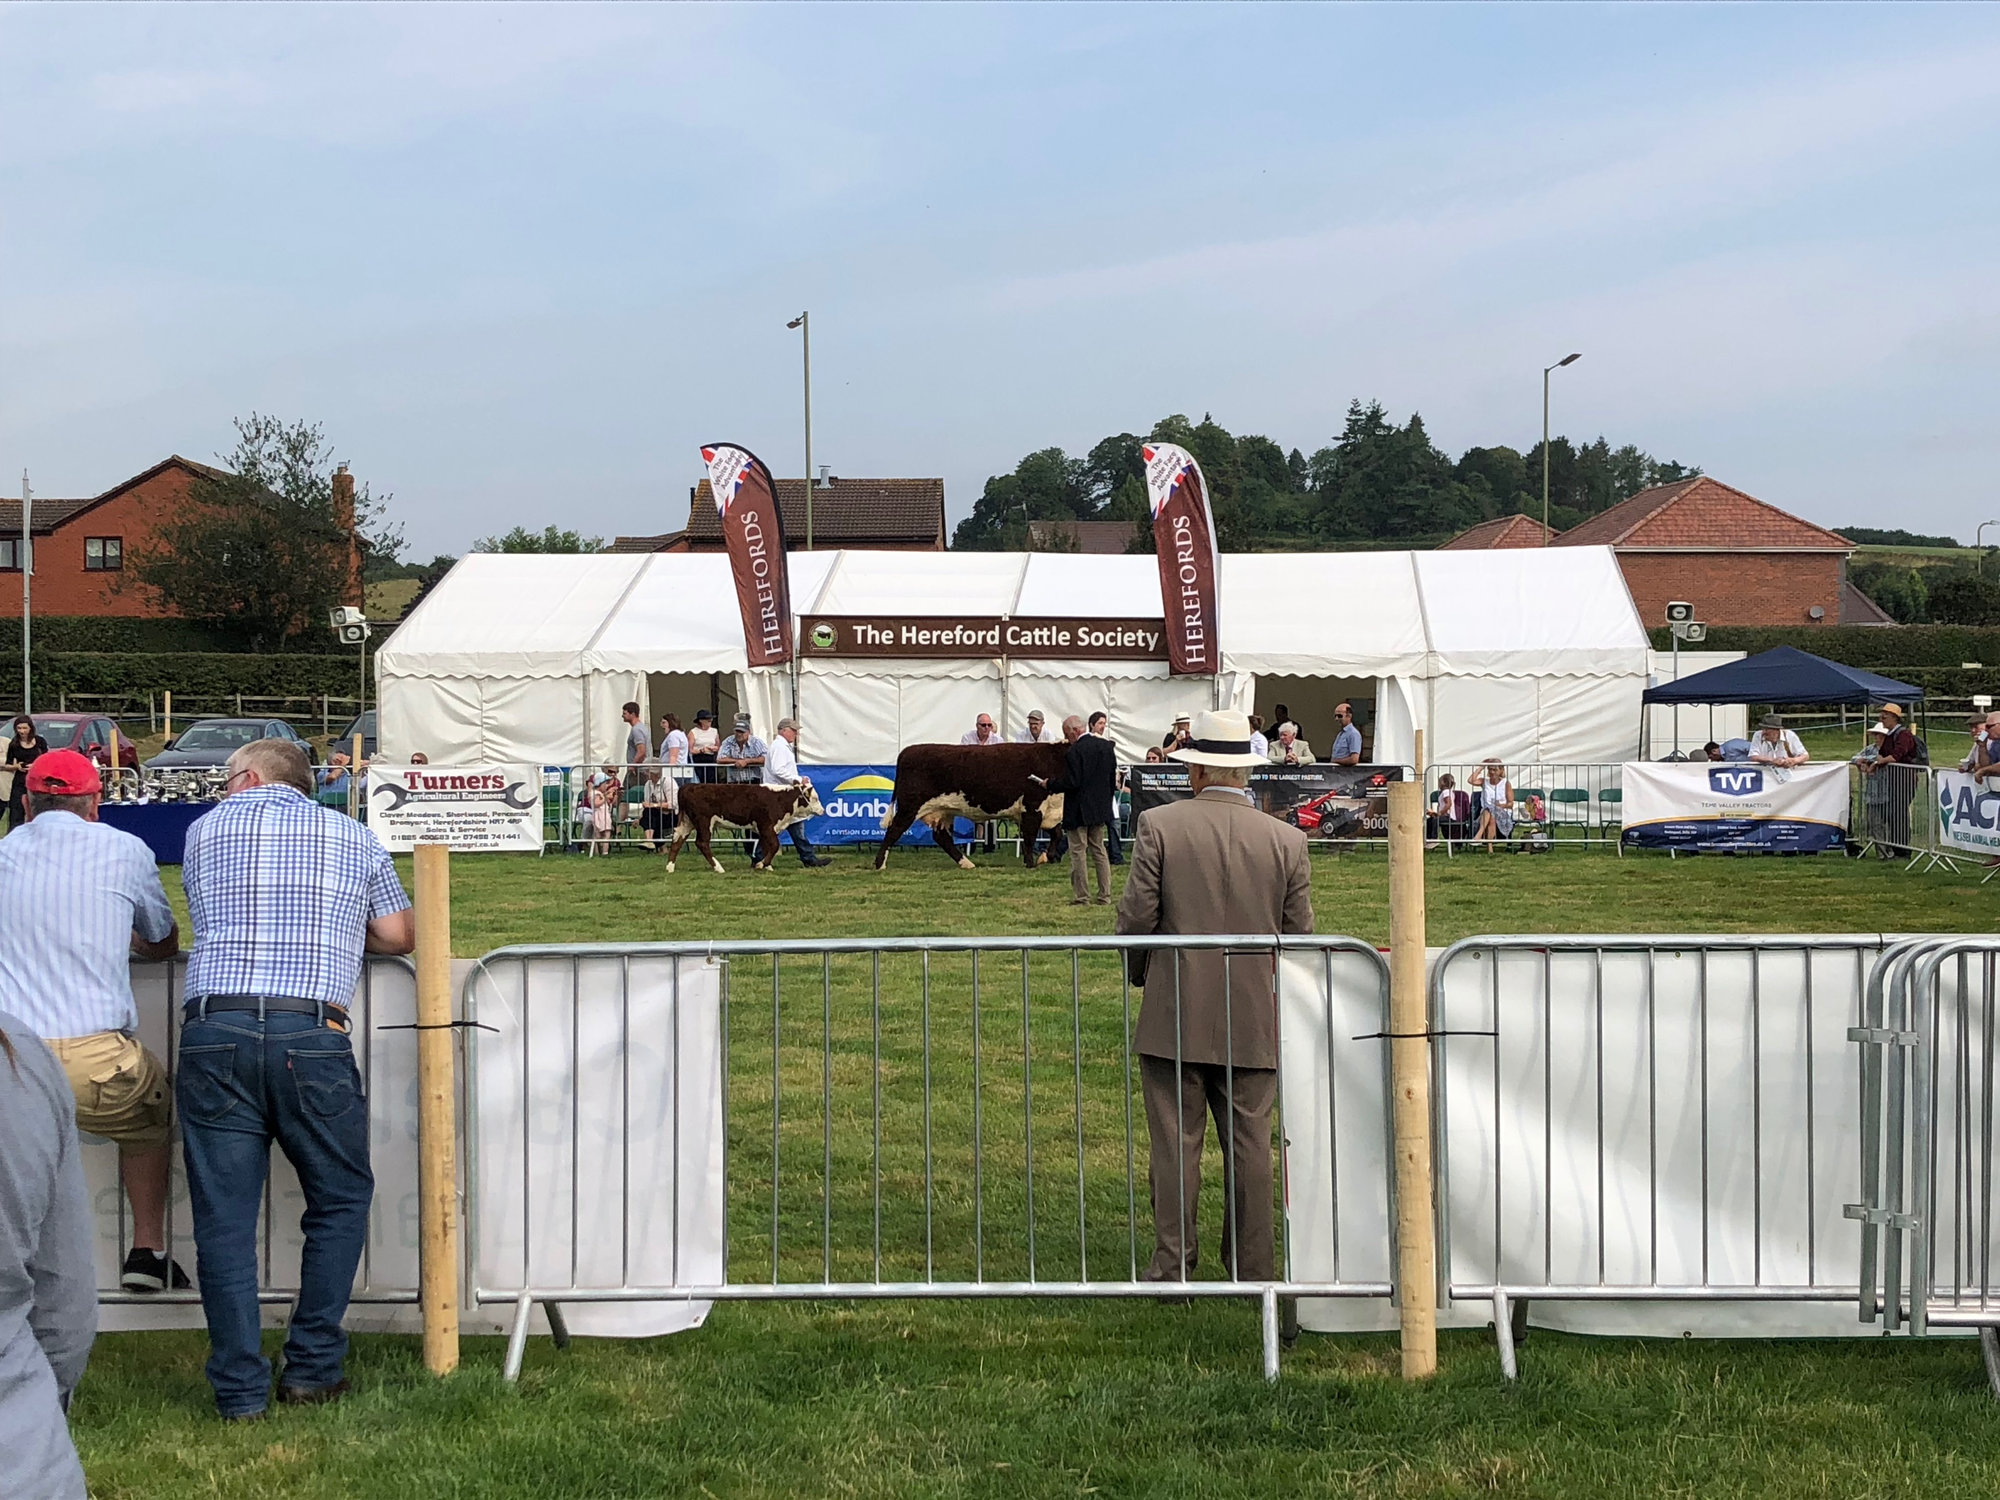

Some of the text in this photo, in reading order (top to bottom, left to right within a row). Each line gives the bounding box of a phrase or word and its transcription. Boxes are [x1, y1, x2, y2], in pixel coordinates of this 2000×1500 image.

[713, 457, 724, 470] The
[1151, 457, 1162, 470] The
[1157, 456, 1182, 491] Advantage
[714, 466, 728, 486] White
[1150, 466, 1166, 486] White
[741, 510, 783, 656] HEREFORDS
[1173, 515, 1206, 666] HEREFORDS
[853, 625, 1159, 652] The Hereford Cattle Society
[403, 771, 505, 790] Turners
[1715, 772, 1757, 791] TVT
[405, 791, 507, 802] Agricultural Engineers
[825, 798, 898, 818] dunb
[1952, 786, 2000, 831] AC
